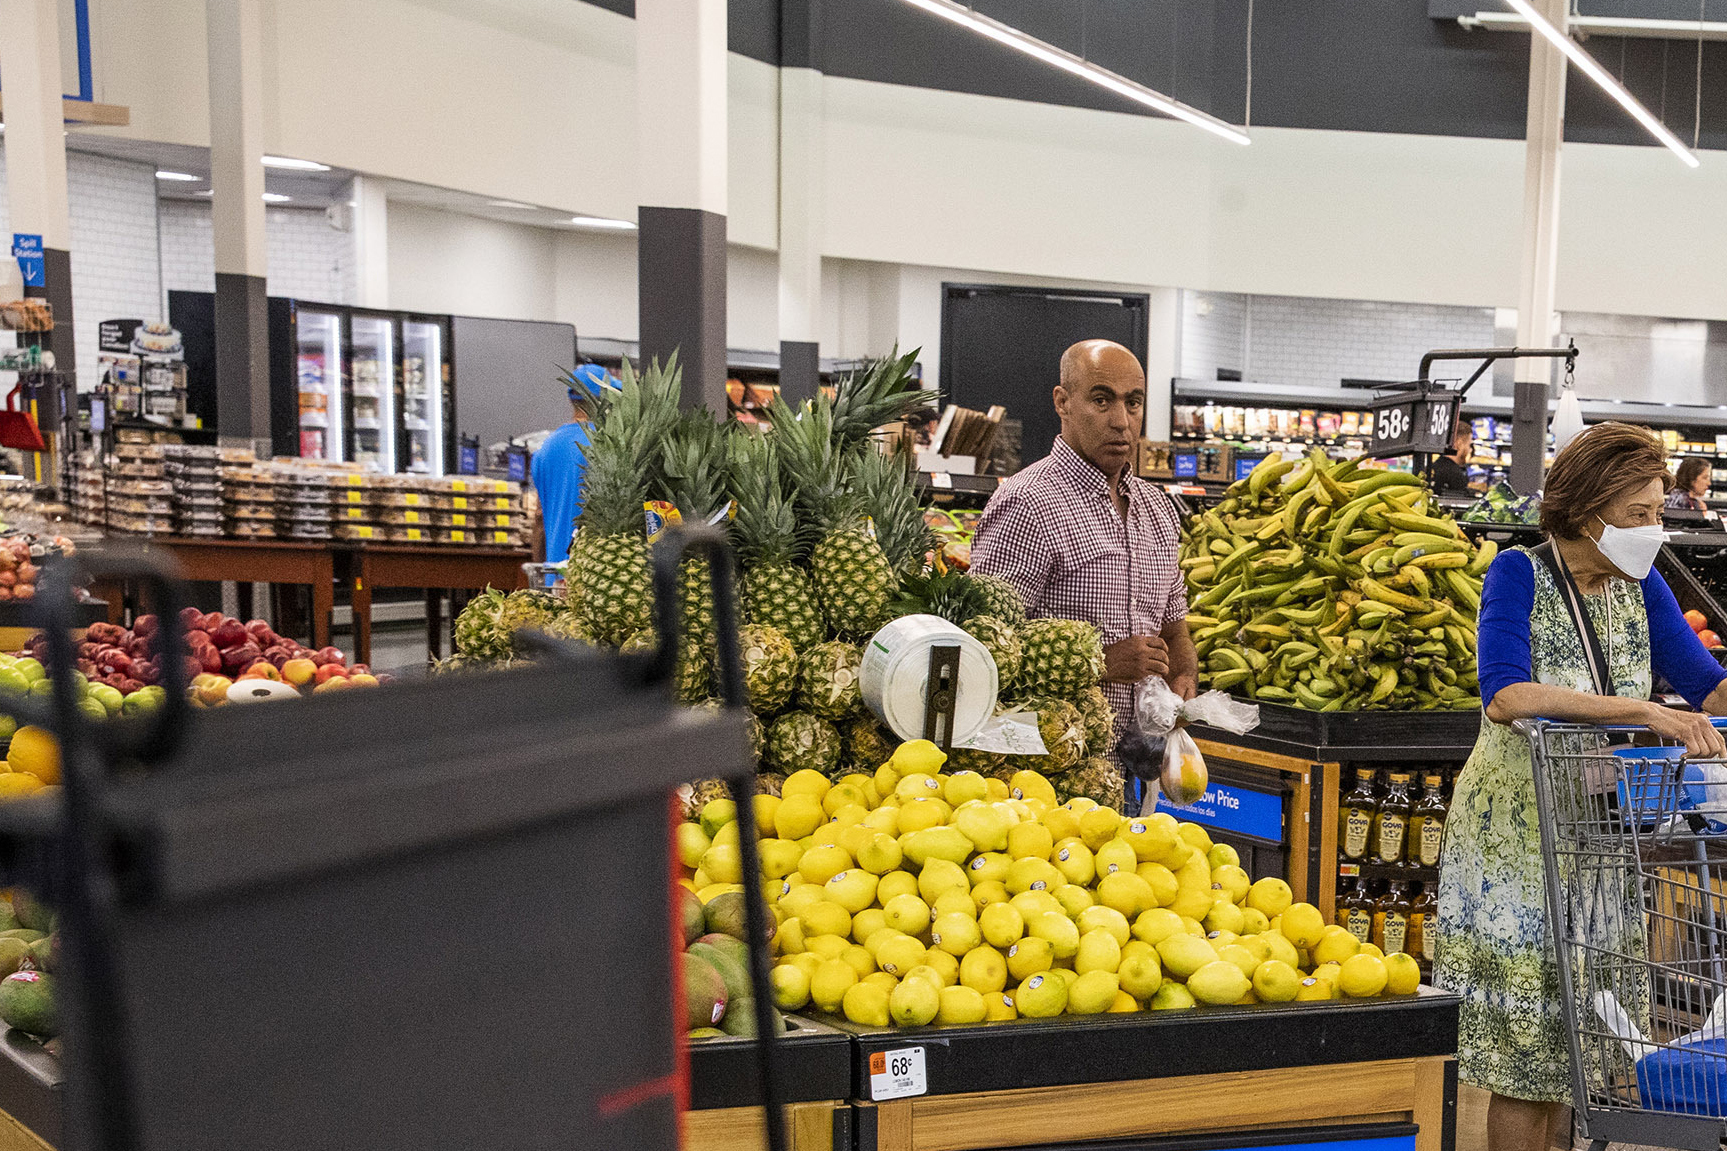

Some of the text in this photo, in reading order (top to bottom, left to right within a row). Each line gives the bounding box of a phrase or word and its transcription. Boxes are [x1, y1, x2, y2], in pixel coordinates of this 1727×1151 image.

[1217, 789, 1239, 809] Price
[1348, 818, 1368, 826] GOYA
[1382, 821, 1402, 829] GOYA
[1348, 917, 1369, 925] GOYA
[1385, 920, 1405, 928] GOYA
[891, 1057, 912, 1077] 68¢
